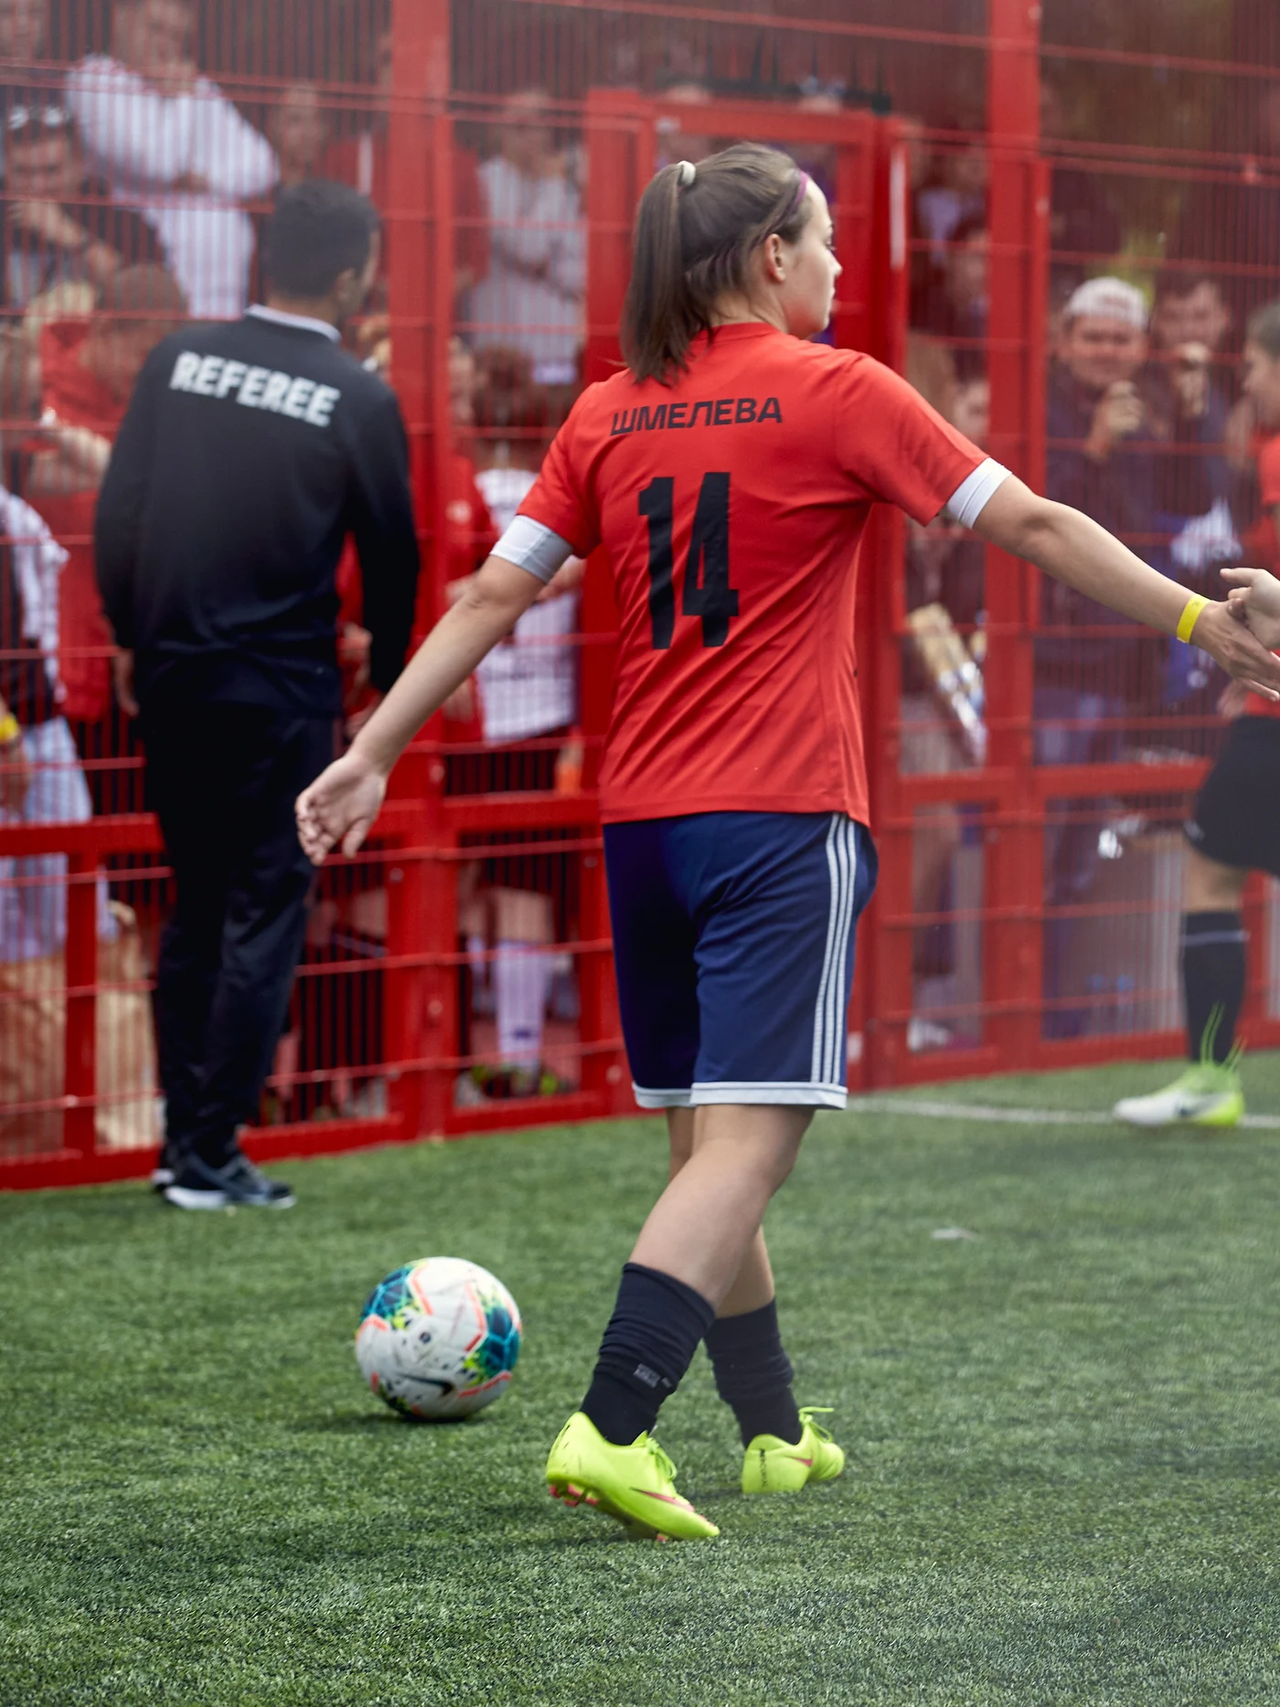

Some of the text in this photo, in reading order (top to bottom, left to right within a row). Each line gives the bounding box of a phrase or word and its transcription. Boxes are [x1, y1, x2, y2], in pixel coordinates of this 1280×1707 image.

[169, 350, 341, 428] REFEREE
[610, 397, 783, 436] ШМЕЛЕВА
[638, 472, 739, 650] 14
